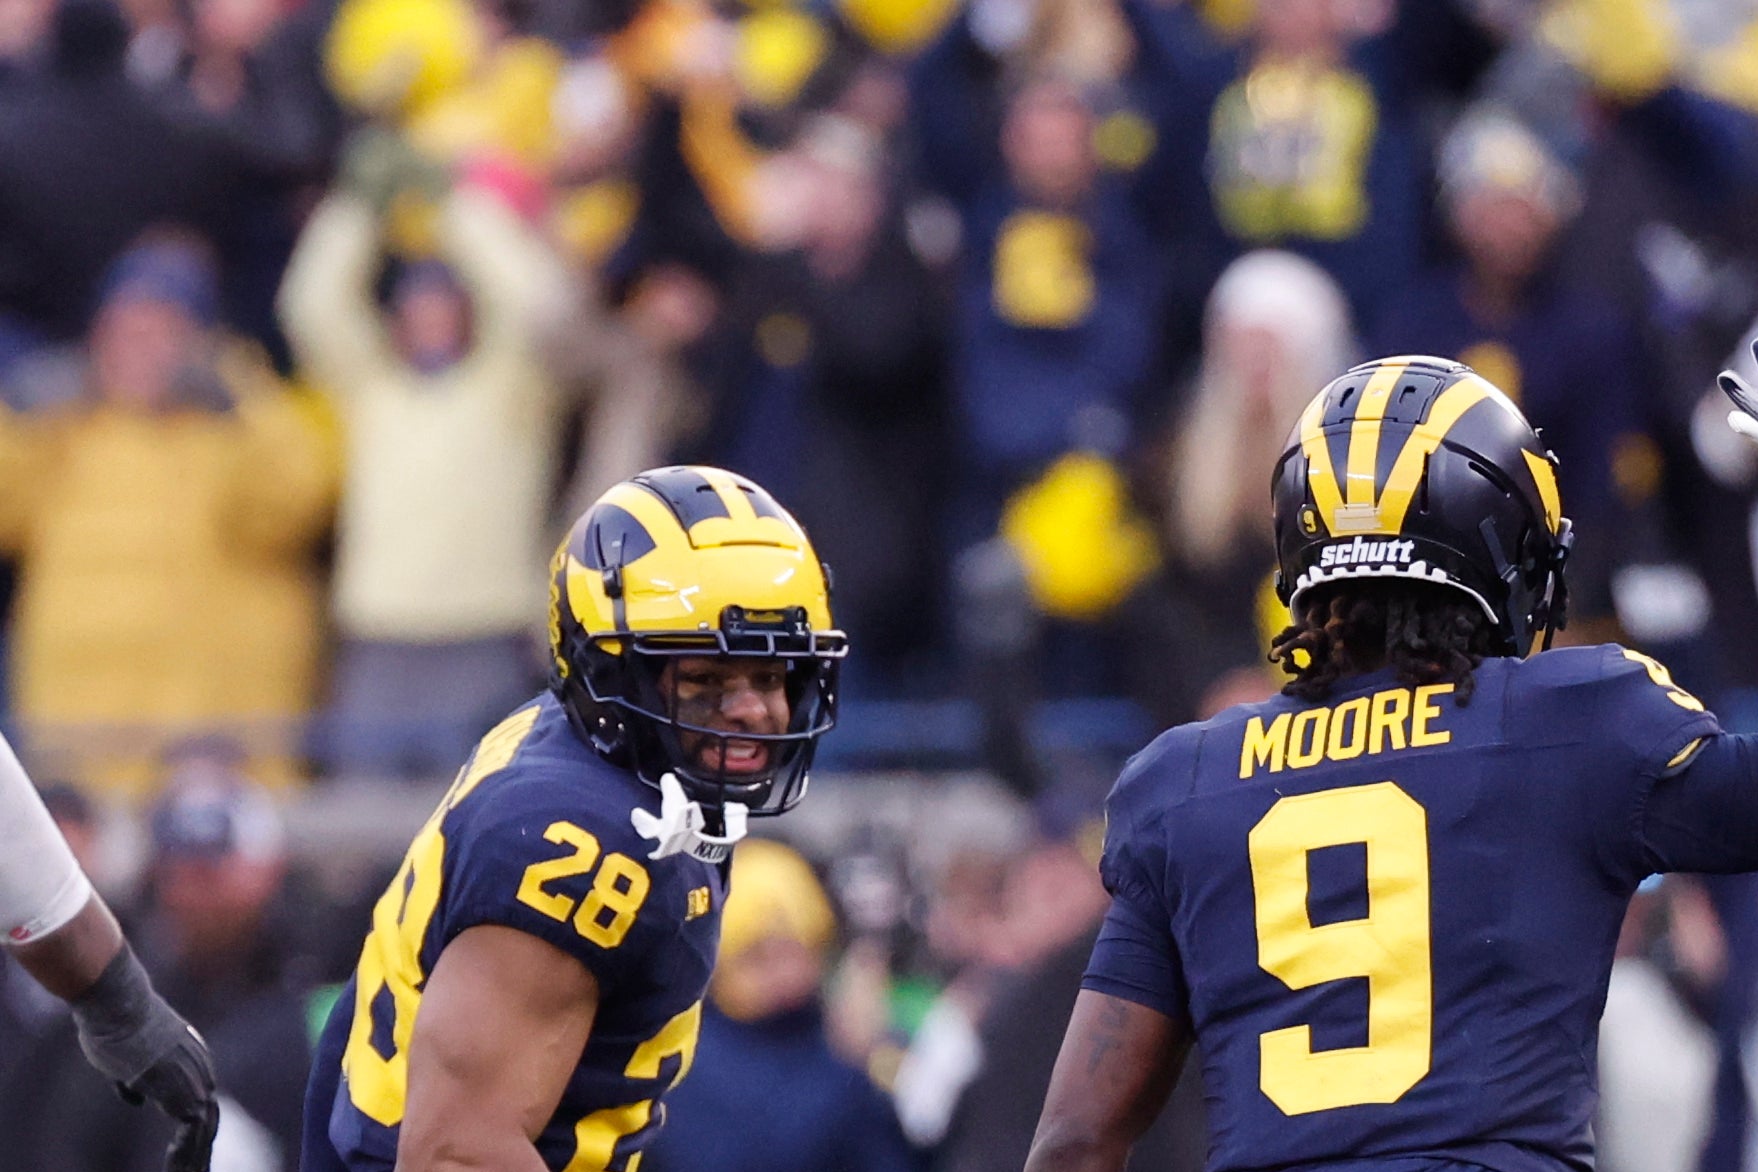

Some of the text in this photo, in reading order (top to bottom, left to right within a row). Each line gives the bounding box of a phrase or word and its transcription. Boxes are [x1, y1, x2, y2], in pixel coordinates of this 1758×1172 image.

[1303, 510, 1316, 532] 9
[1320, 536, 1415, 567] schutt
[1239, 683, 1455, 779] MOORE
[516, 820, 651, 949] 28
[1248, 781, 1431, 1116] 9
